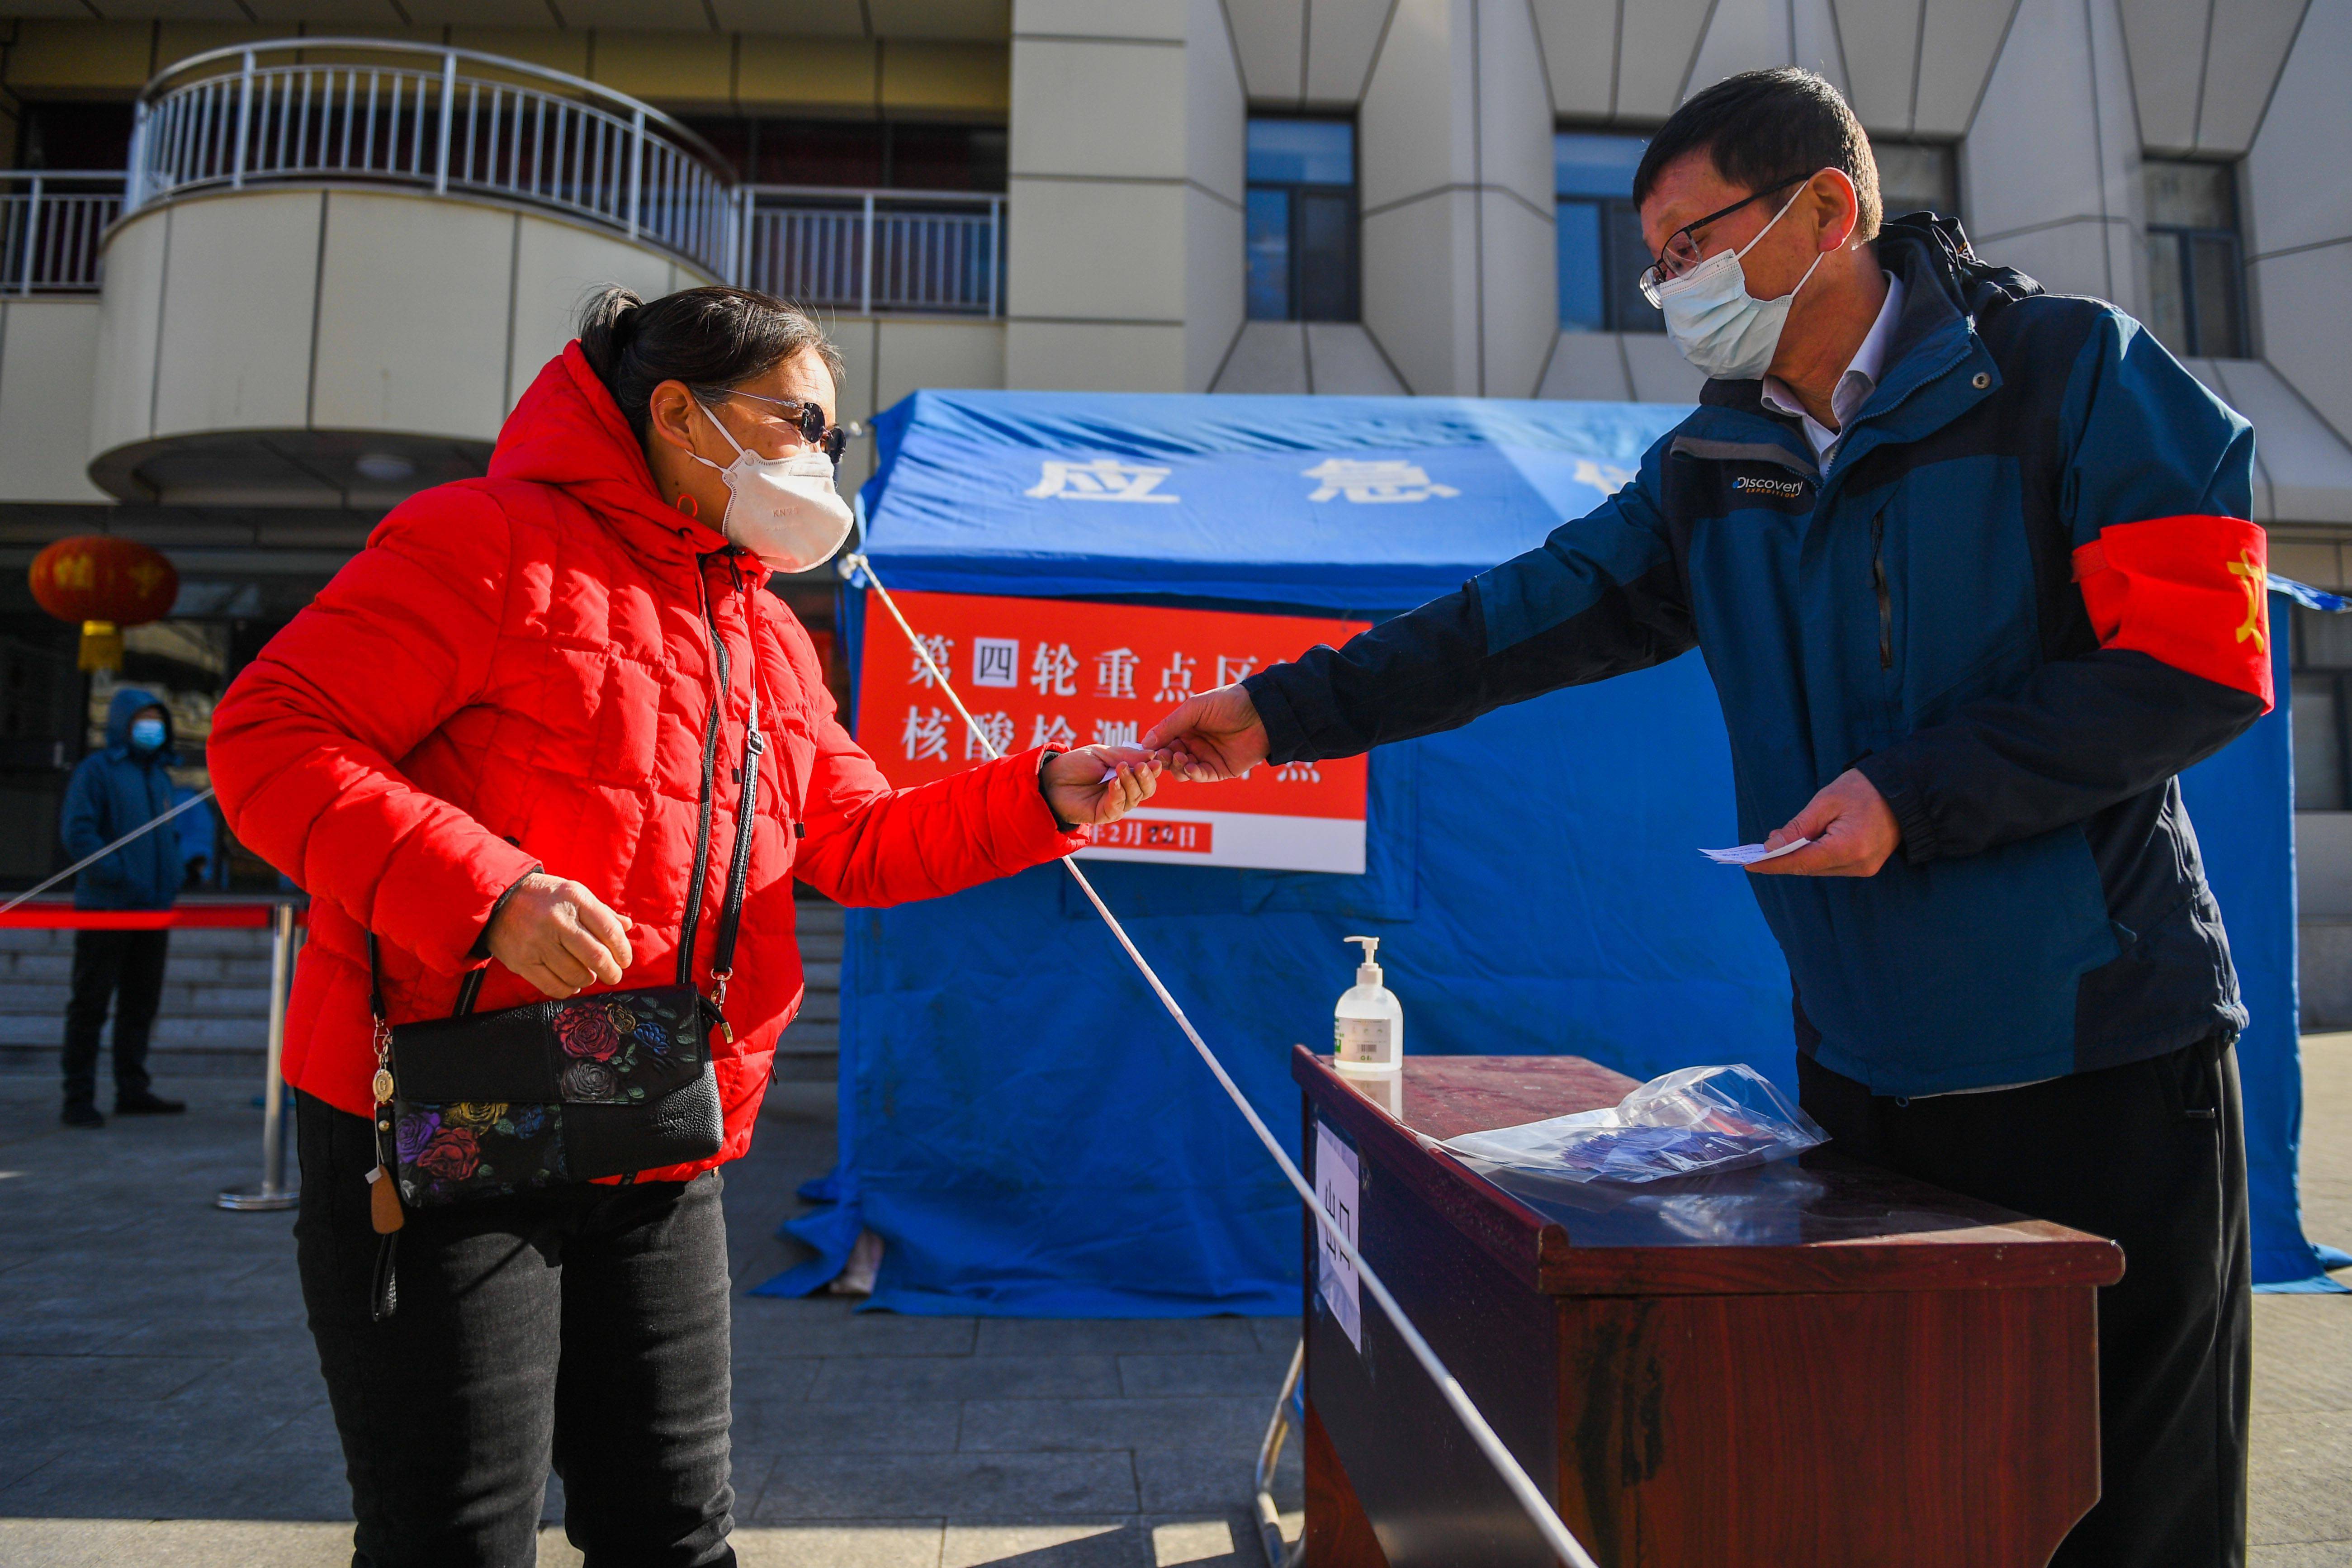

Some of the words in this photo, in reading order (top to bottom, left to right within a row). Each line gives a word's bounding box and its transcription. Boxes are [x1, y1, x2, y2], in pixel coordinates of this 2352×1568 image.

[1746, 488, 1796, 498] EXPEDITION
[2226, 549, 2271, 660] 文
[908, 634, 1288, 702] 第四轮重点区
[378, 1079, 386, 1091] G
[1325, 1179, 1350, 1270] 出口
